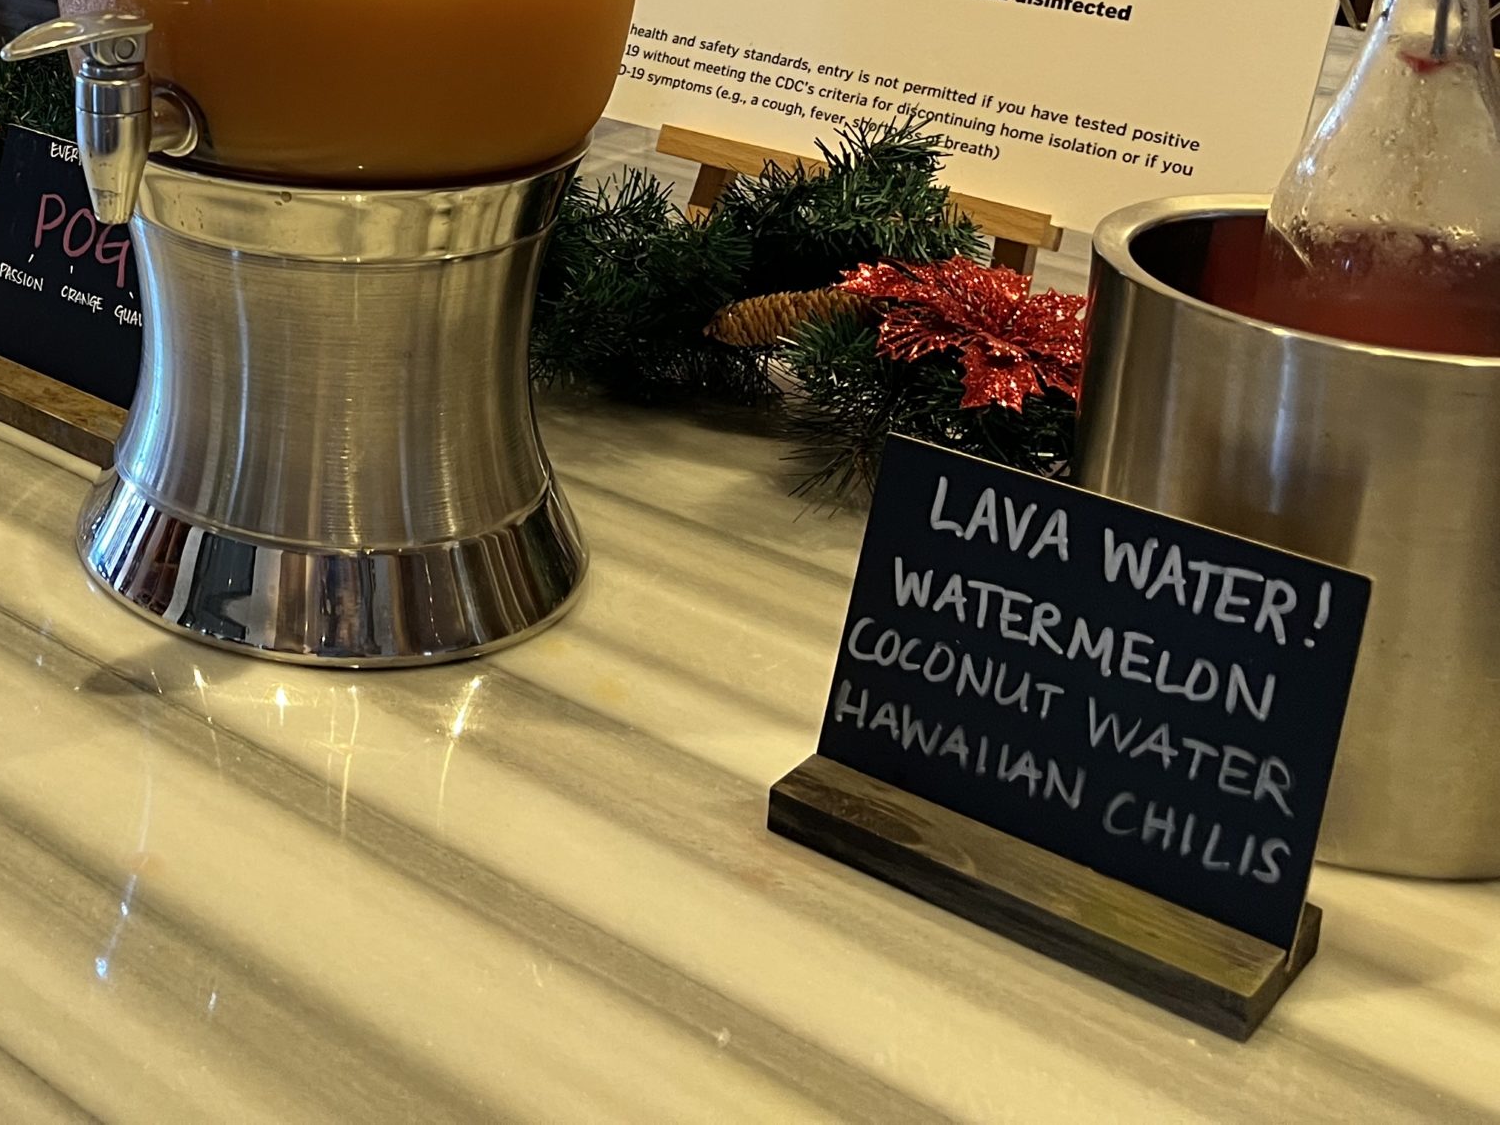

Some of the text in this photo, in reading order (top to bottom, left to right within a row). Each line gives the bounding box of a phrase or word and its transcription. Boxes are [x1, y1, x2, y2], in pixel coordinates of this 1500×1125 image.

[629, 23, 1201, 153] health and safety standards, entry is not permitted if you have tested positive
[643, 47, 691, 69] without
[693, 60, 747, 83] meeting
[749, 69, 772, 86] the
[774, 75, 816, 96] CDC's
[818, 86, 869, 108] criteria
[872, 95, 894, 113] for
[896, 101, 997, 137] discontinuing
[999, 122, 1045, 145] home
[1048, 132, 1118, 161] isolation
[1121, 149, 1141, 166] or
[1144, 152, 1158, 169] if
[1160, 159, 1194, 177] you
[647, 71, 713, 97] symptoms
[715, 84, 748, 106] (e.g.,
[750, 94, 760, 107] a
[761, 96, 806, 119] cough,
[944, 135, 1001, 161] breath)
[50, 141, 83, 166] EVER
[0, 262, 45, 292] PASSION
[34, 193, 131, 288] POG
[929, 475, 1332, 649] LAVA WATER!
[893, 556, 1277, 723] WATERMELON
[833, 678, 1292, 885] HAWAIIAN CHILIS
[846, 615, 1295, 819] COCONUT WATER
